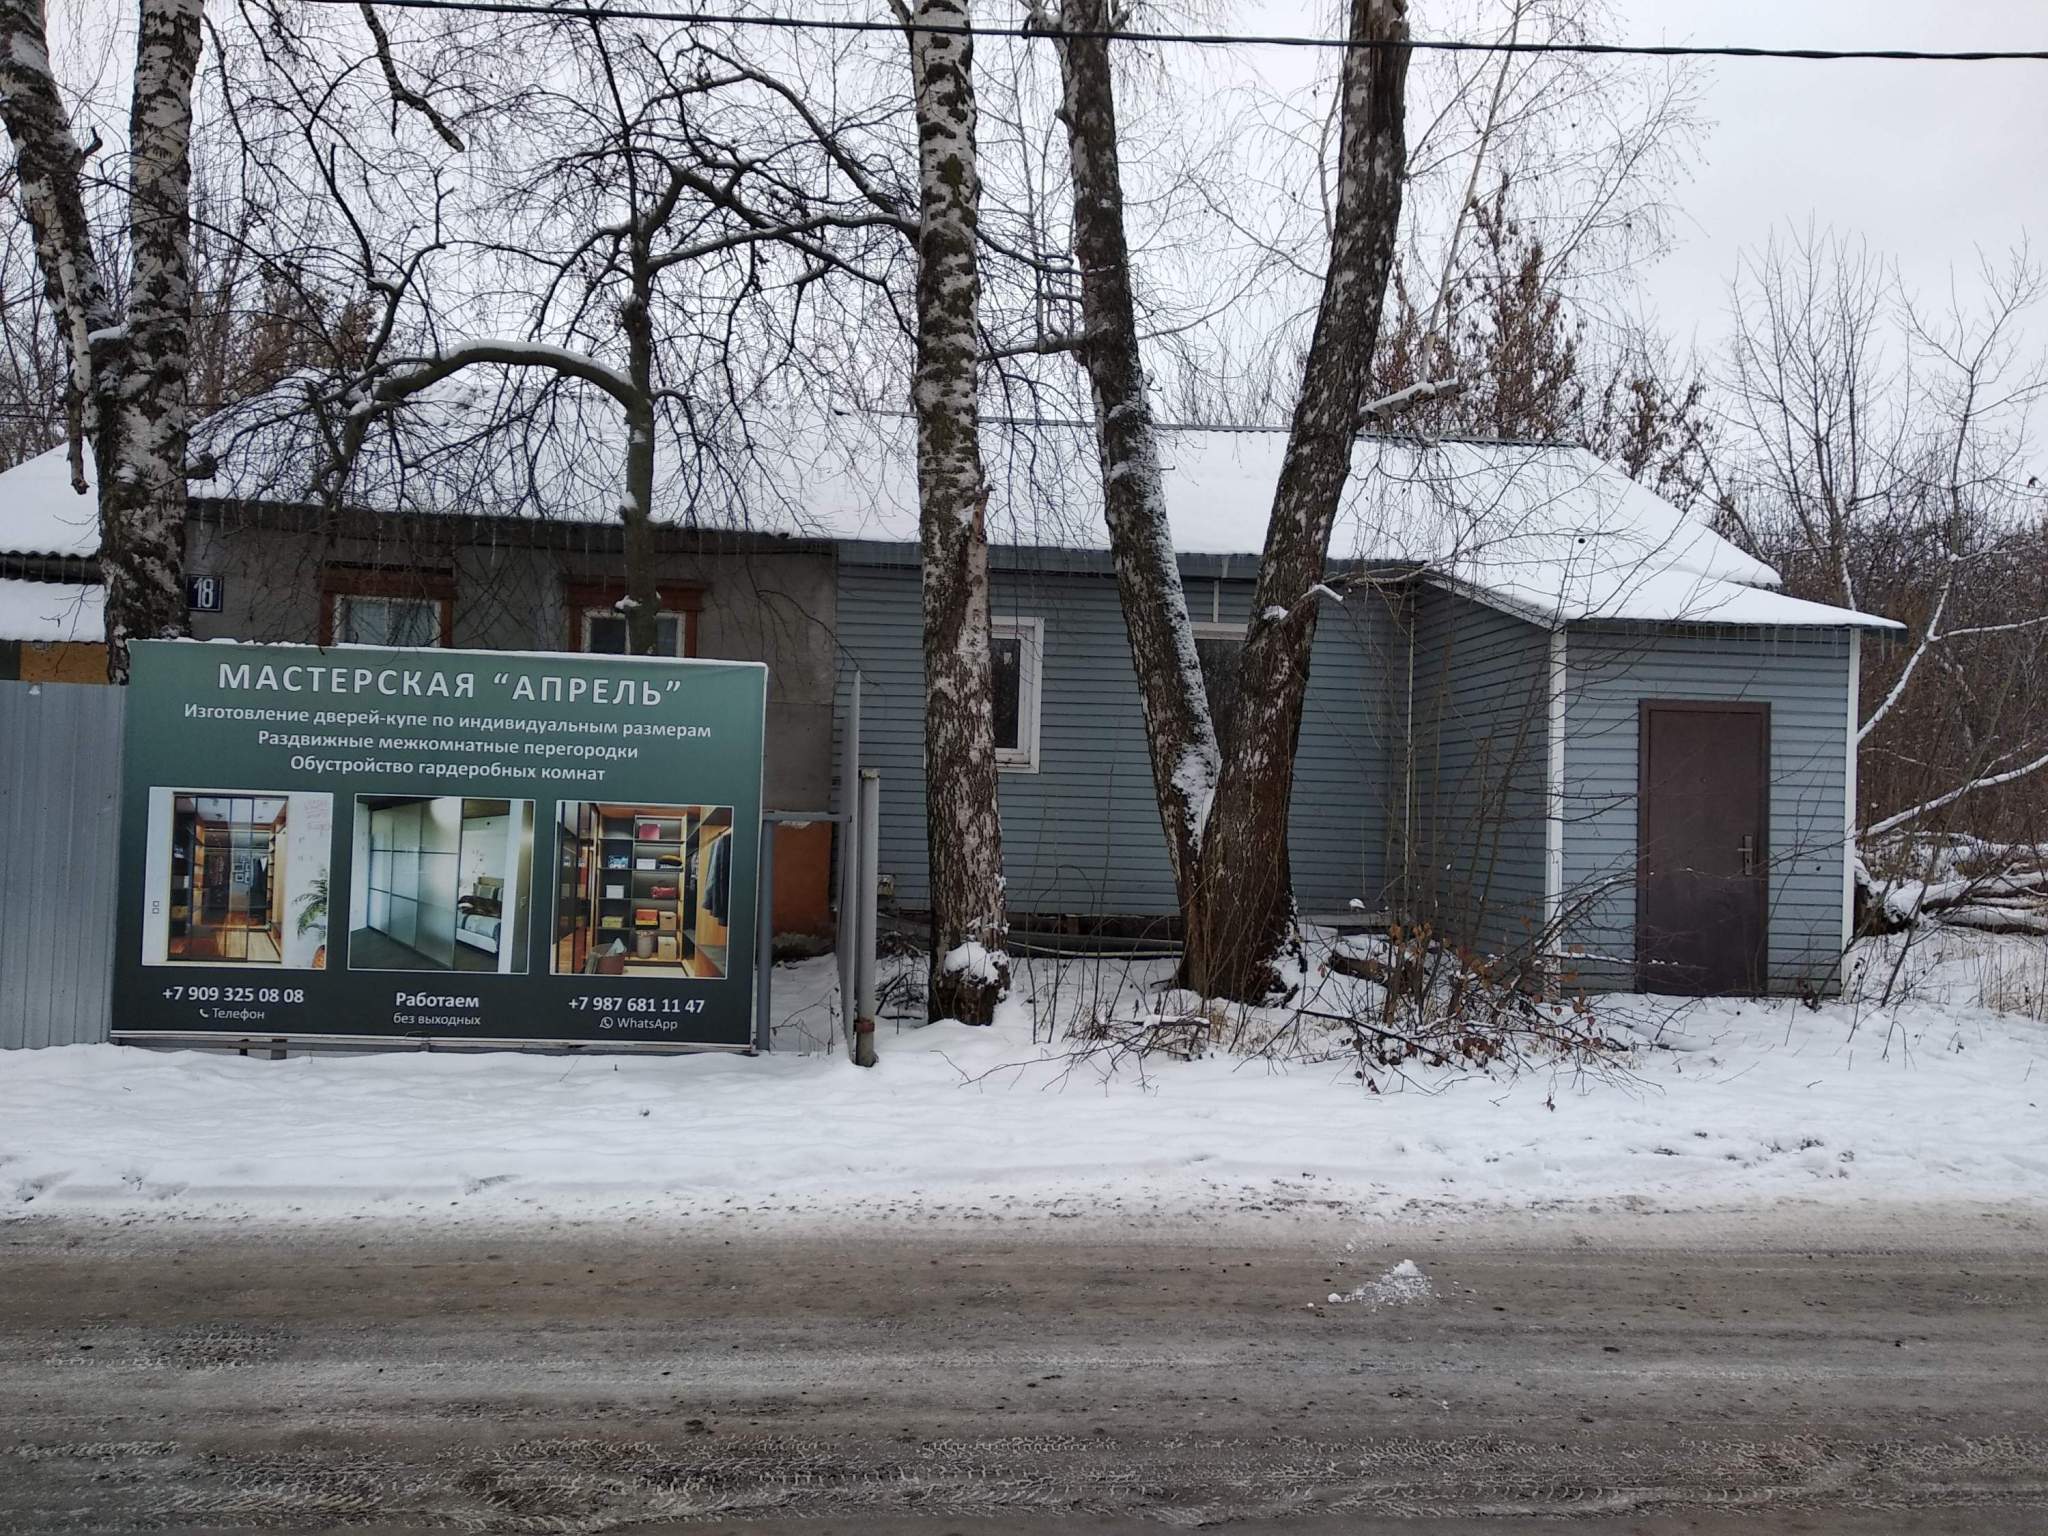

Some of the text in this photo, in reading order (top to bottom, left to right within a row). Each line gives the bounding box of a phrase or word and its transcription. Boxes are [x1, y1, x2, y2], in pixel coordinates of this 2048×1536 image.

[193, 577, 214, 608] 18
[218, 663, 681, 706] МАСТЕРСКАЯ “АПРЕЛЬ”
[184, 703, 712, 742] Изготовление дверей-купе по индивидуальным размерам
[258, 730, 639, 760] Раздвижные межкомнатные перегородки
[290, 755, 606, 781] Обустройство гардеробных комнат
[162, 986, 304, 1004] +7 909 325 08 08
[395, 992, 480, 1008] Работаем
[212, 1007, 265, 1021] Телефон
[568, 996, 705, 1014] +7 987 681 11 47
[393, 1012, 481, 1027] без выходных
[617, 1017, 678, 1032] WhatsApp
